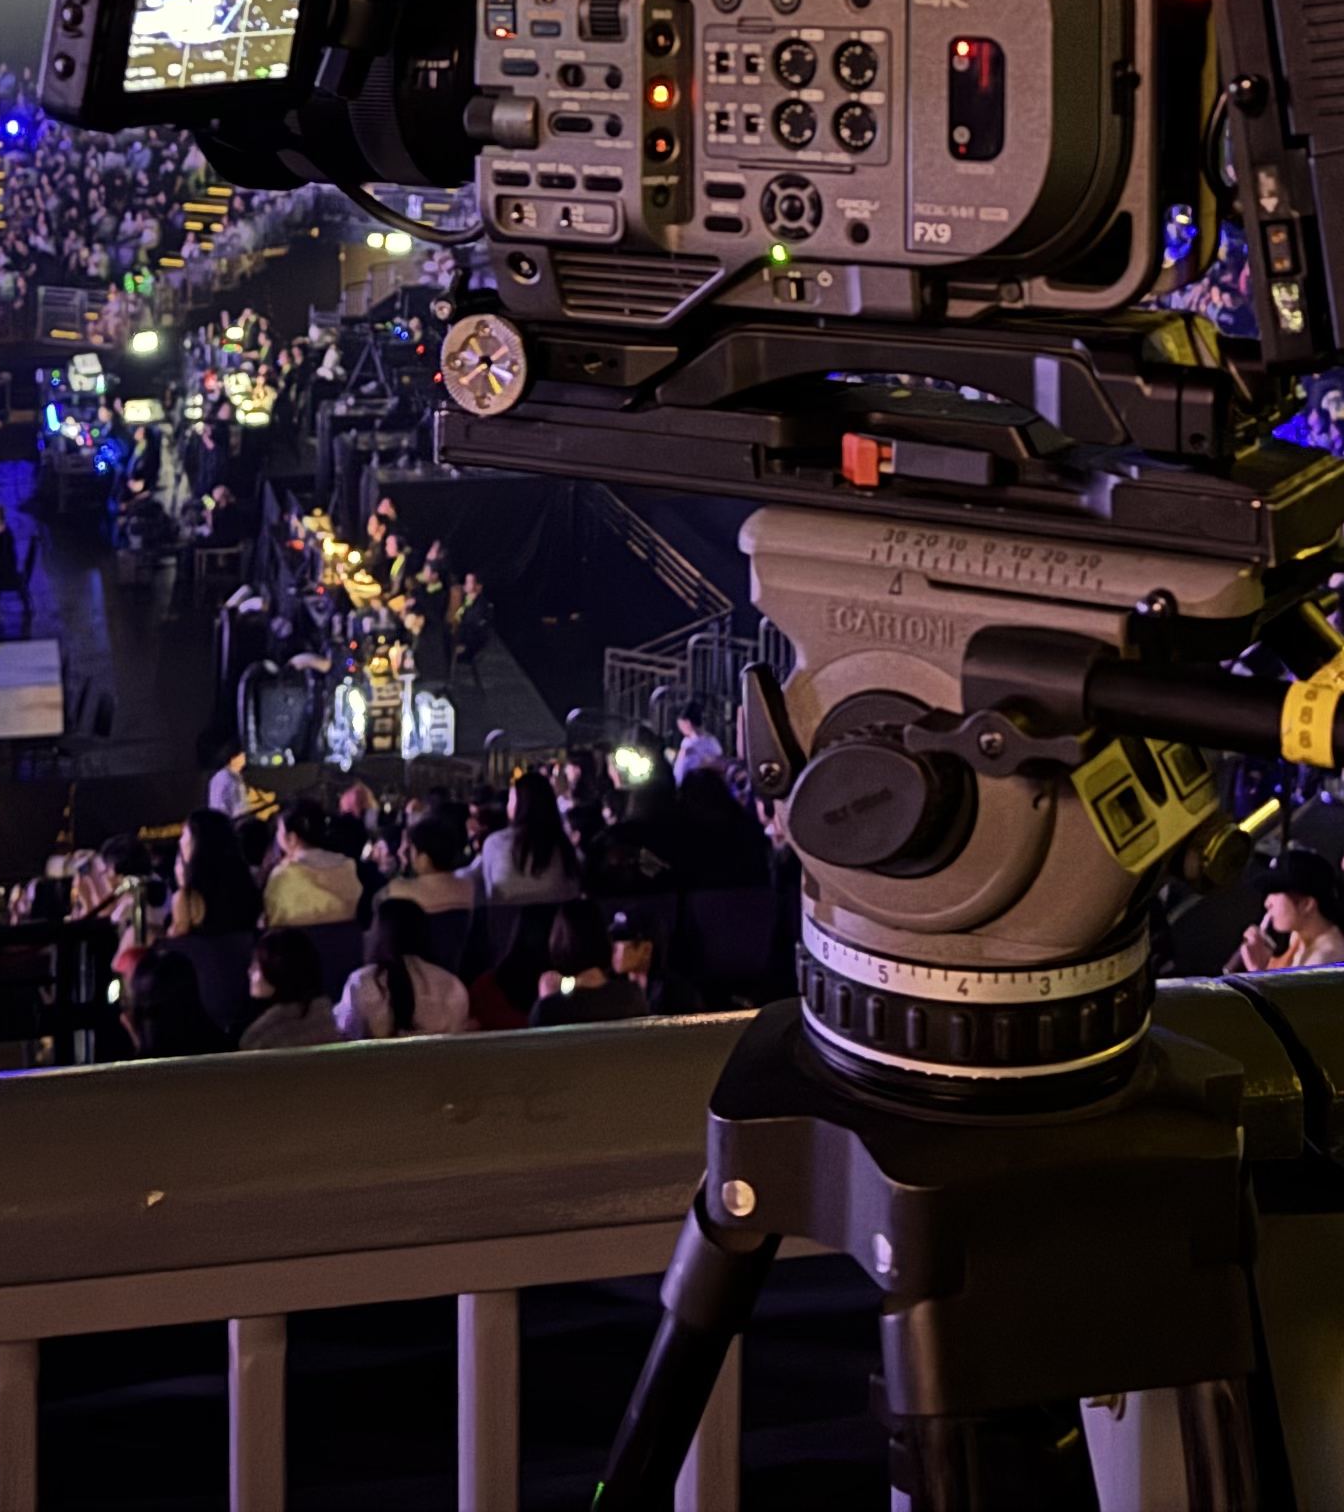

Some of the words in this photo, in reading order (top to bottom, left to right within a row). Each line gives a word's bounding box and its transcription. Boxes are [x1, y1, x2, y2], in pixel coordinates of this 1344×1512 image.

[913, 221, 952, 245] FX9
[833, 606, 956, 649] CARTONI
[878, 964, 890, 984] 5
[956, 978, 970, 997] 4
[1039, 976, 1052, 996] 3
